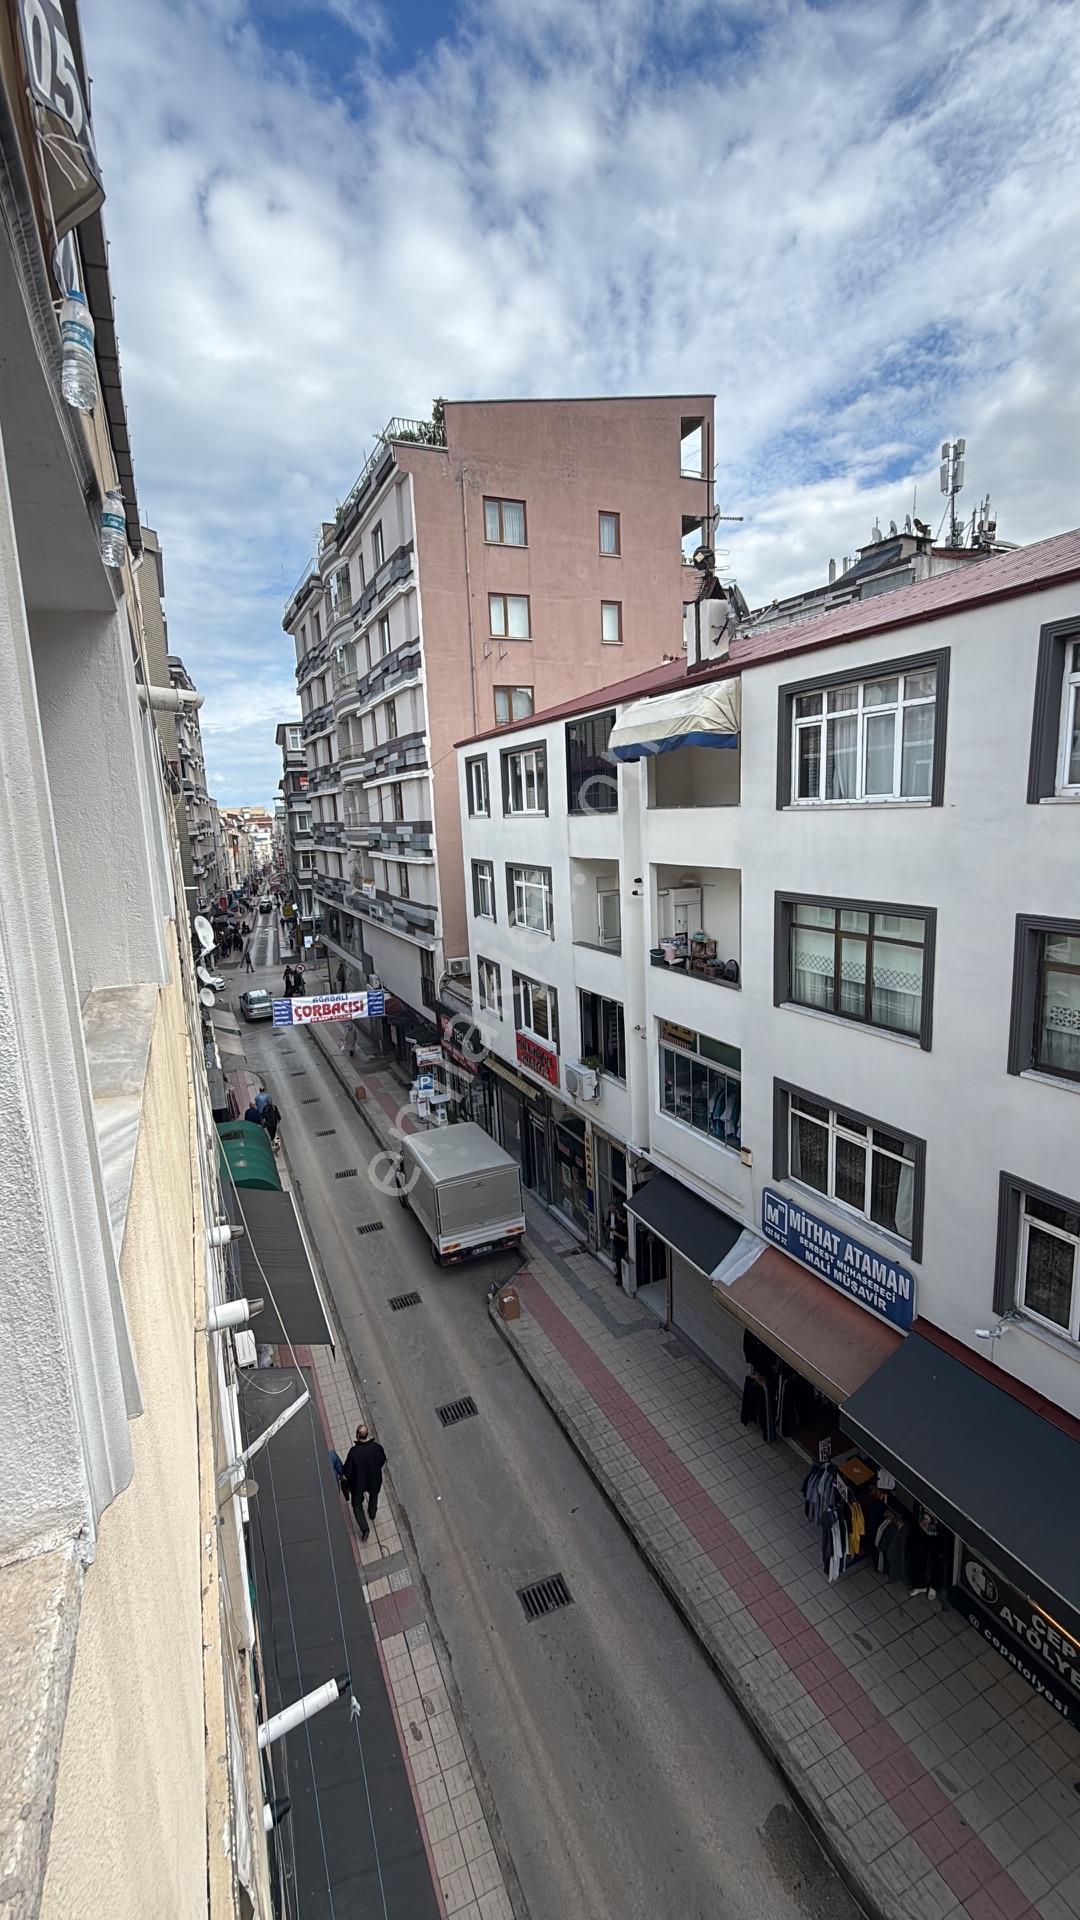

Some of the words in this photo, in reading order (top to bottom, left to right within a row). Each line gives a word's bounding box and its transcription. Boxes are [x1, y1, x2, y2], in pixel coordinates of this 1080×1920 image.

[420, 1076, 431, 1090] P
[789, 1208, 841, 1256] MİTHAT
[844, 1243, 910, 1300] ATAMAN
[799, 1236, 835, 1264] SERBEST
[836, 1259, 897, 1304] MUHASEBECİ
[804, 1250, 832, 1275] MALİ
[833, 1267, 887, 1312] MÜŞAVİR
[1031, 1614, 1077, 1658] CEP
